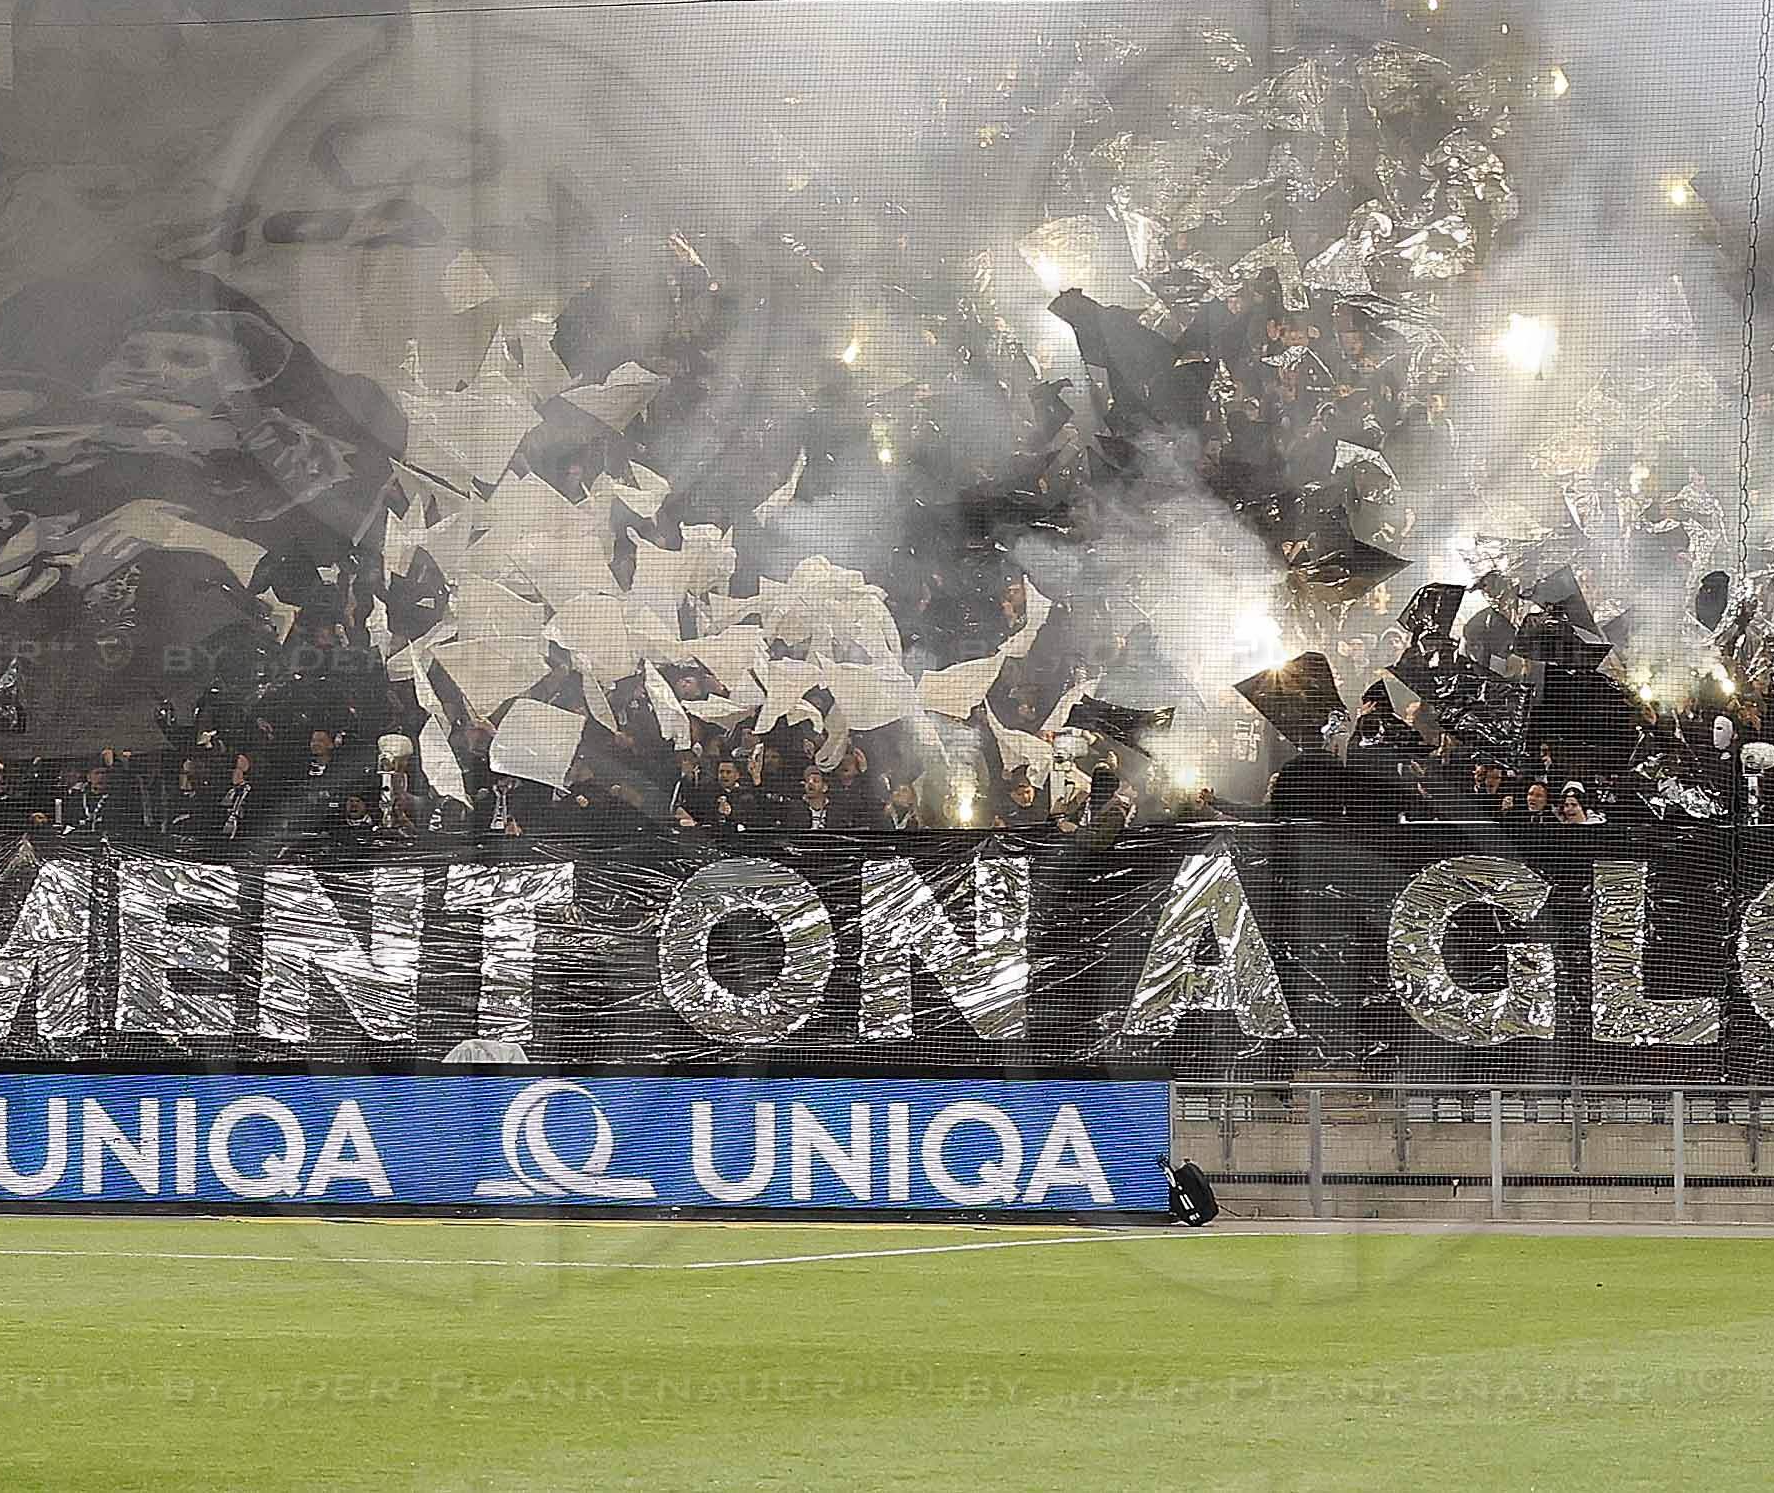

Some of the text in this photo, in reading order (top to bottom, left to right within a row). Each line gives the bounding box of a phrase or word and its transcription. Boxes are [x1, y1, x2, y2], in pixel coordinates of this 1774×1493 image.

[657, 854, 1030, 1043] ON
[1119, 850, 1298, 1040] A
[690, 1100, 1115, 1206] UNIQA
